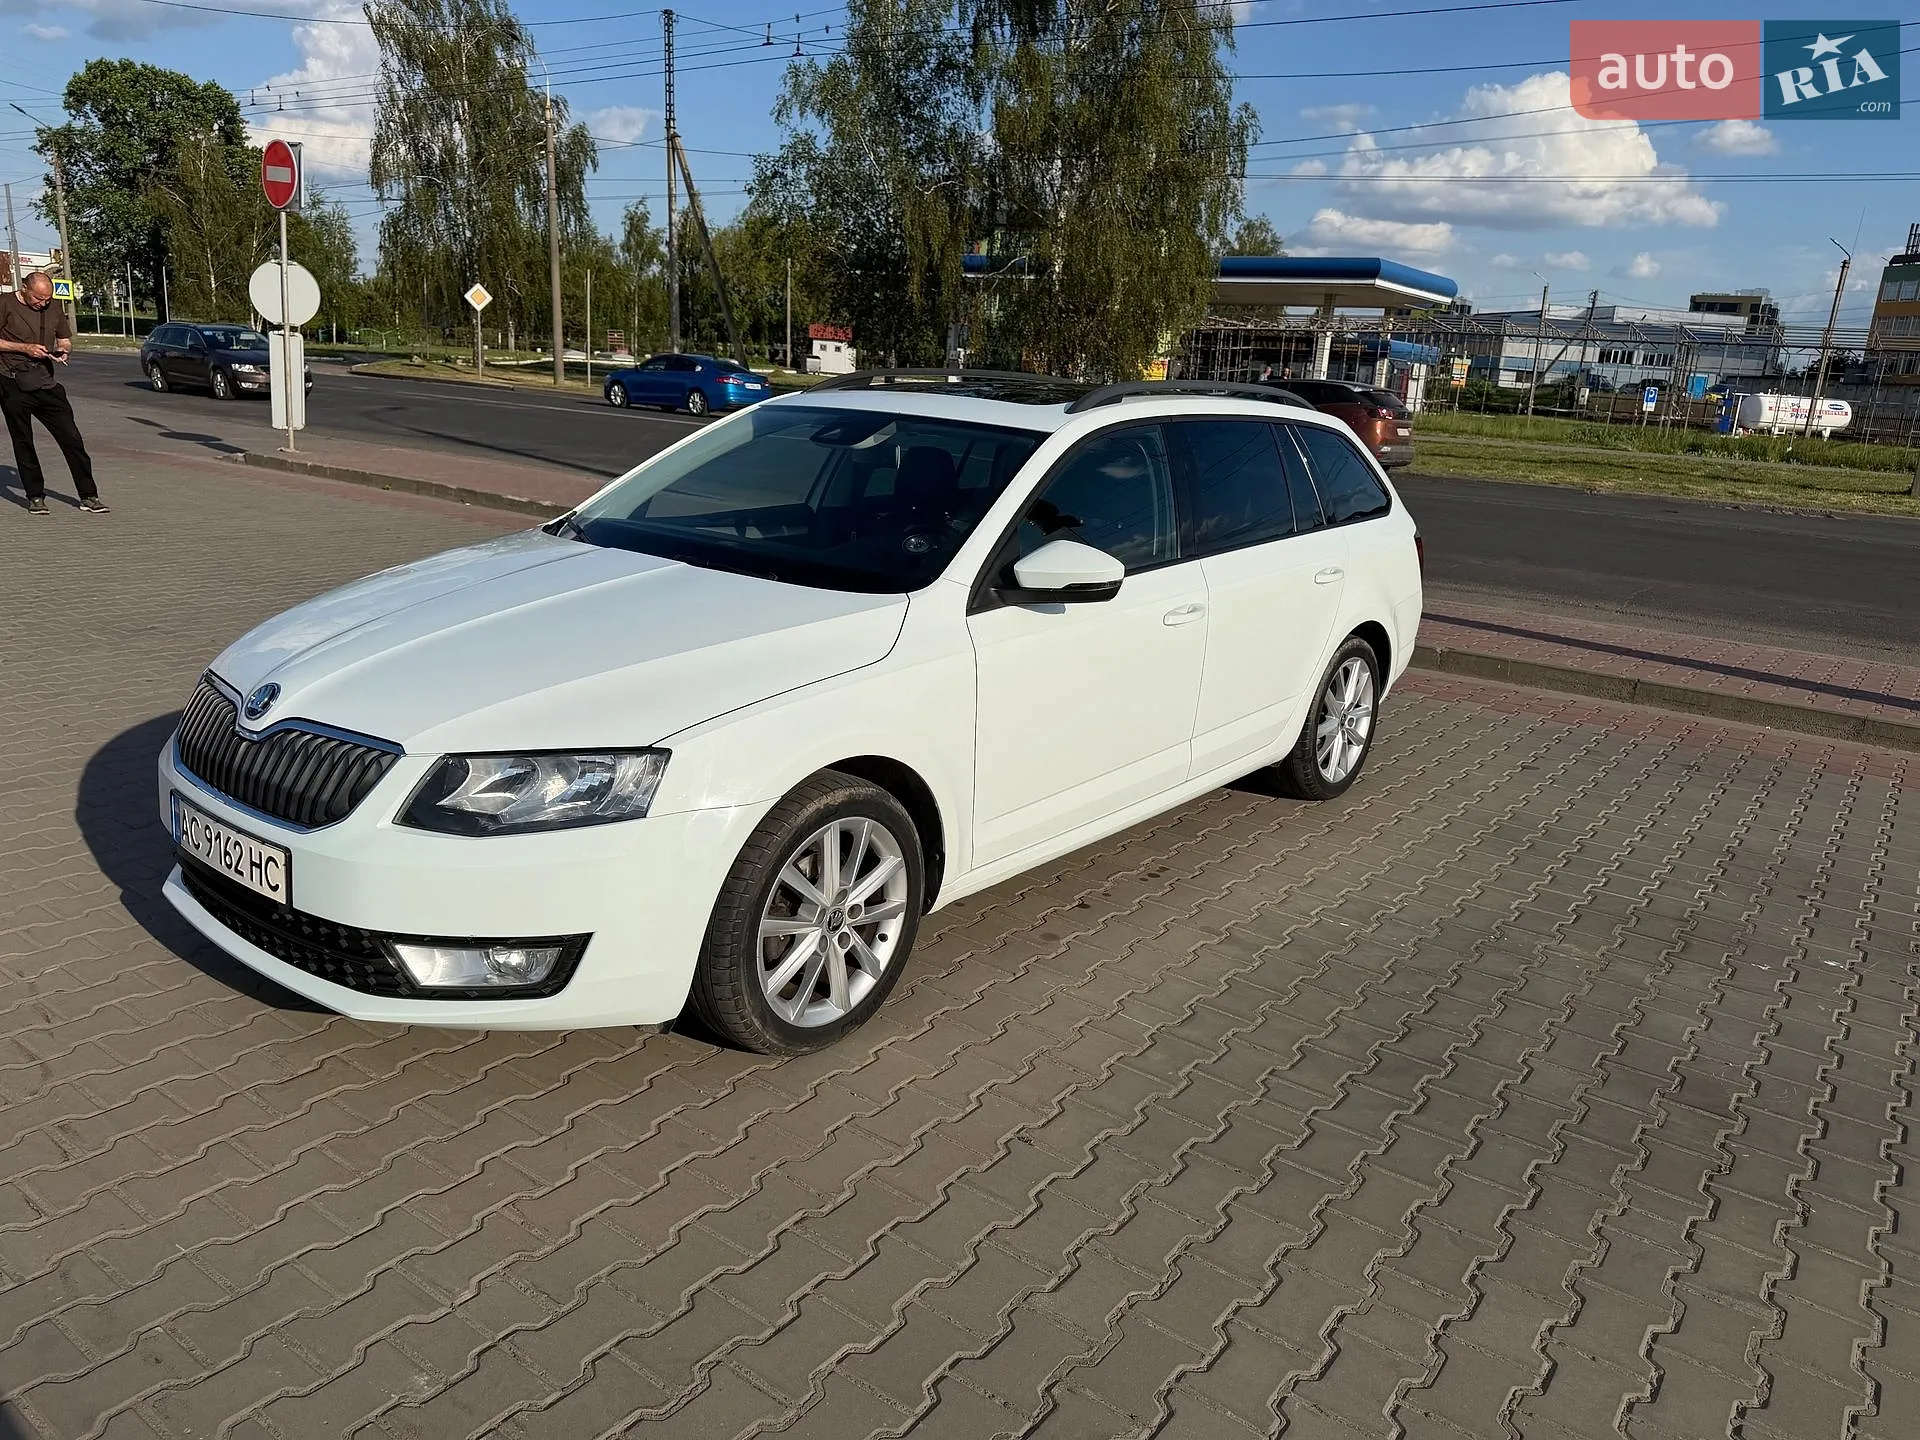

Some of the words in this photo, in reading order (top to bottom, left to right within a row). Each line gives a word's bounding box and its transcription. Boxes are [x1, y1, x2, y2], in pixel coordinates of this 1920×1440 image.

[182, 808, 202, 850] AC
[204, 824, 245, 878] 9162
[249, 845, 281, 892] HC
